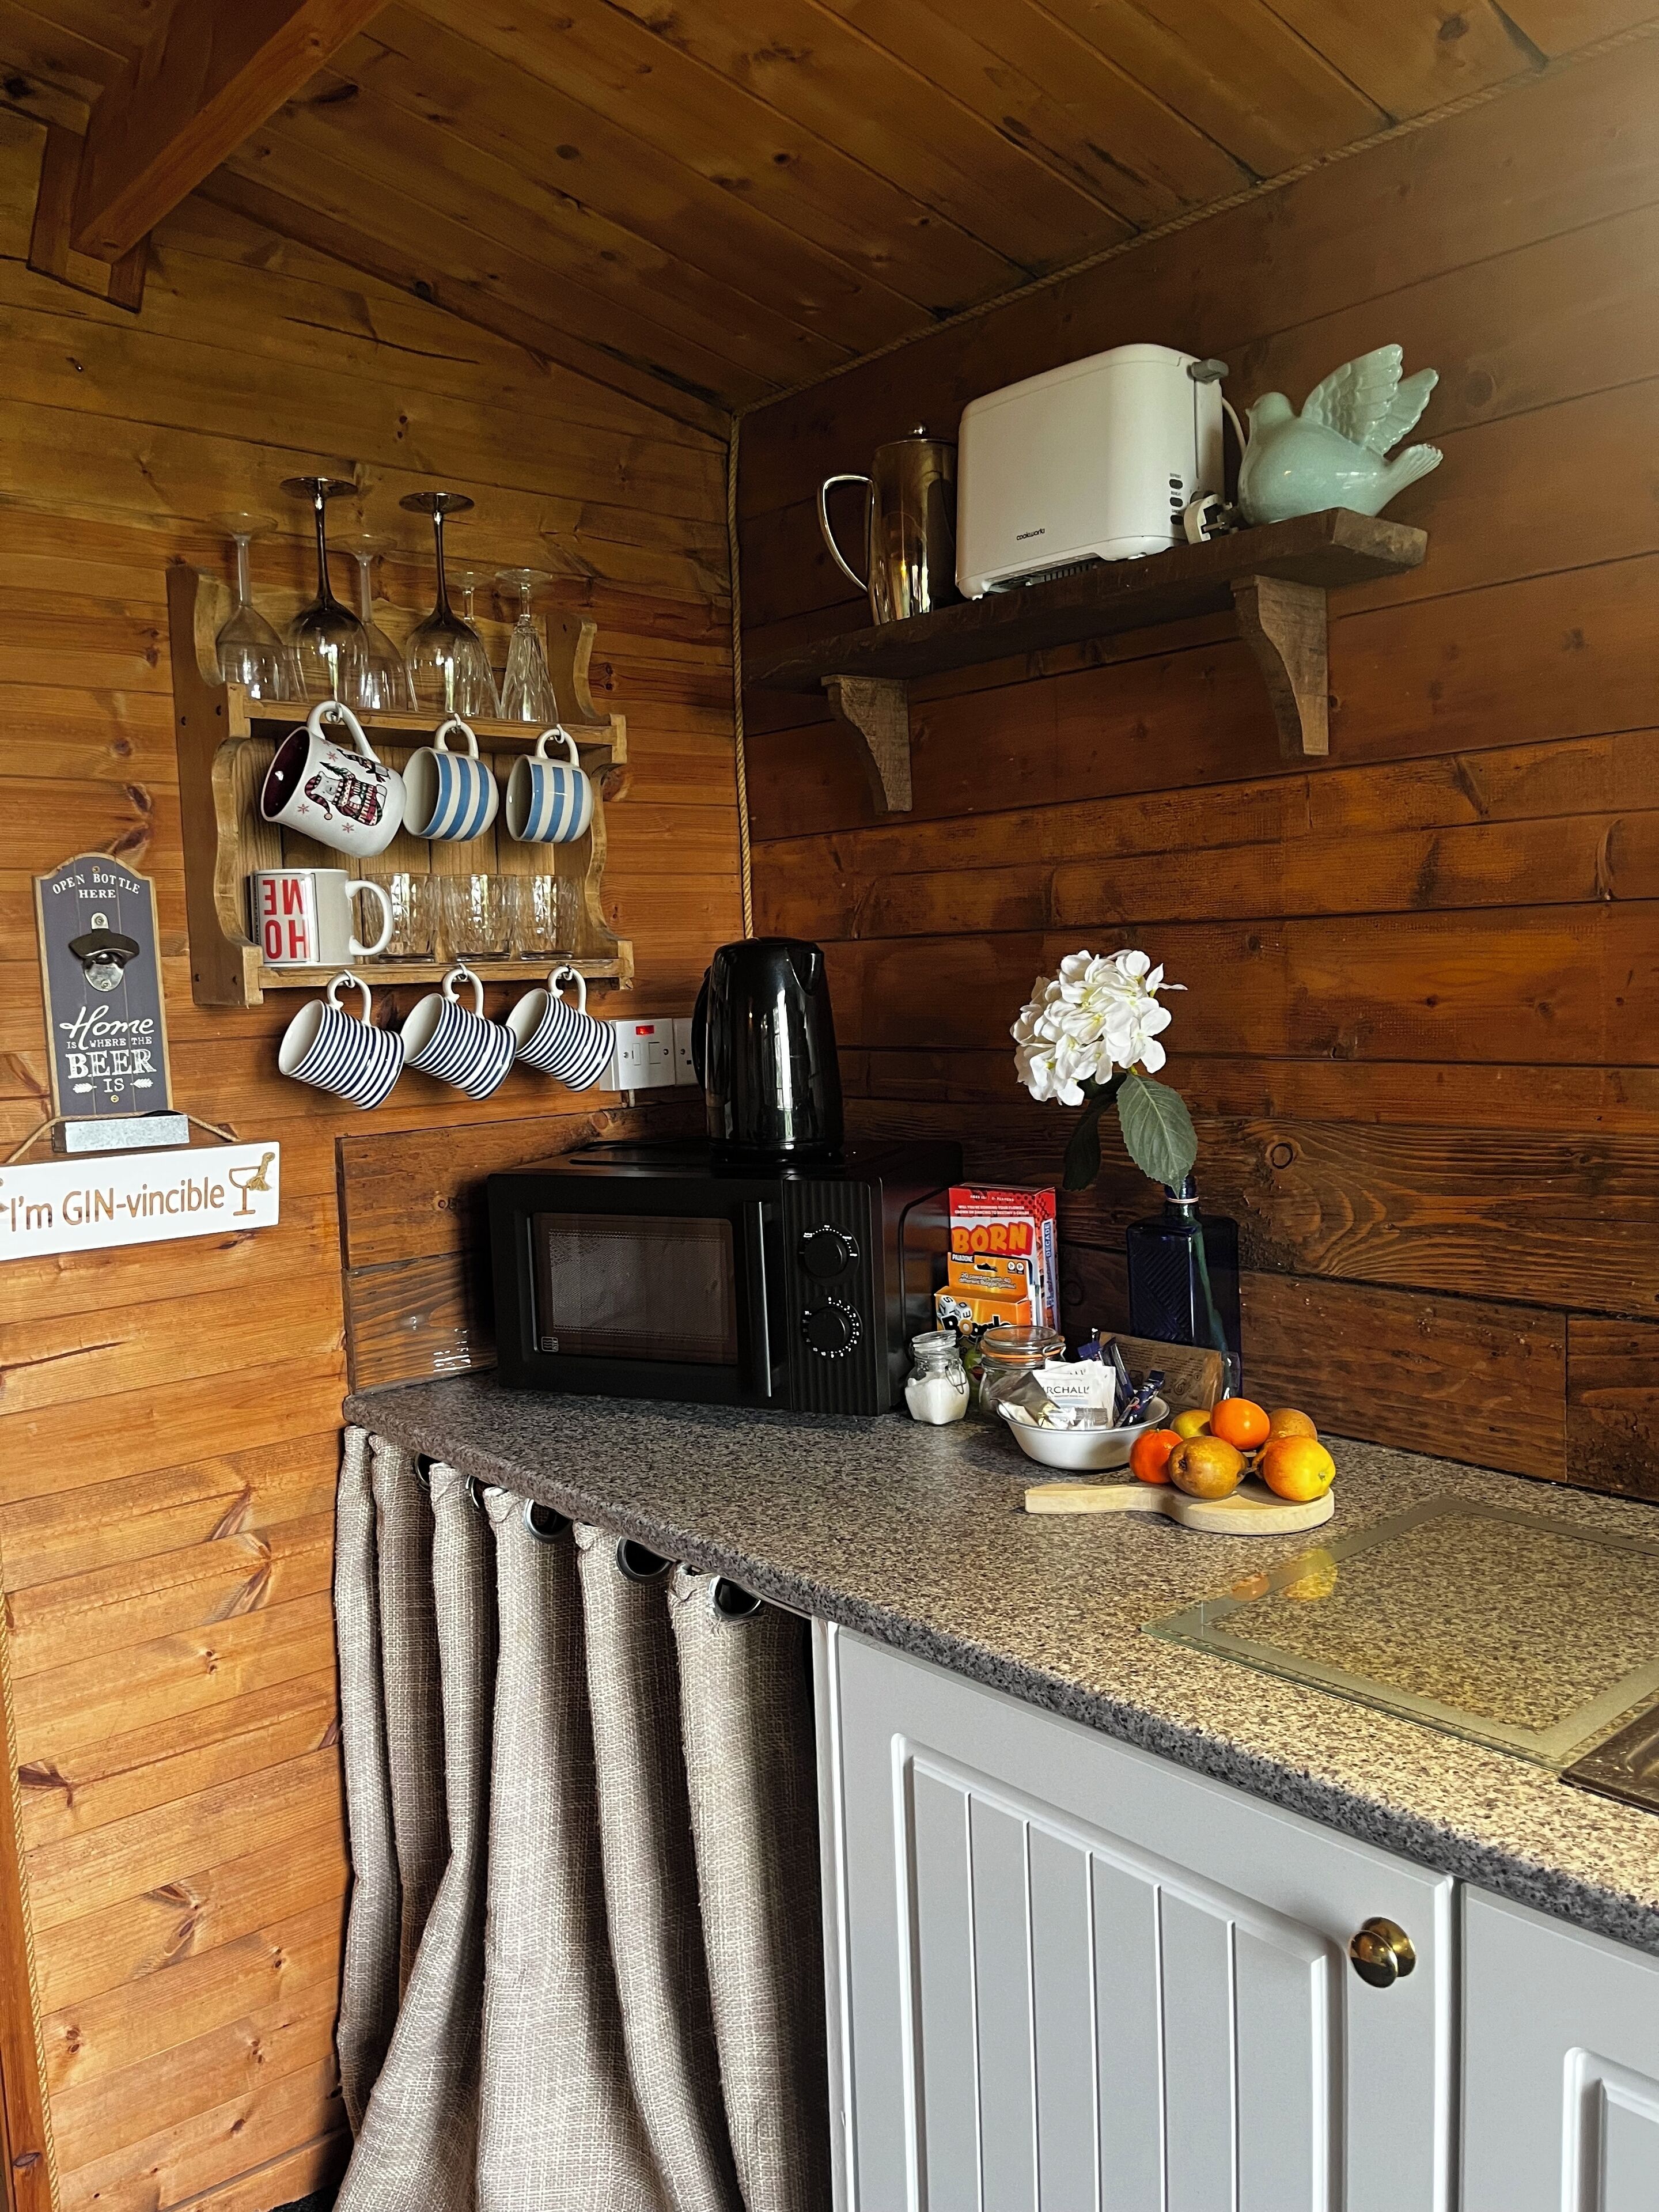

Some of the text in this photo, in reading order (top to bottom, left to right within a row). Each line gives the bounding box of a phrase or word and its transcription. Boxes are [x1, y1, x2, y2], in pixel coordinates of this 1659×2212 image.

[52, 873, 141, 895] OPEN BOTTLE
[78, 889, 116, 899] HERE
[59, 1005, 154, 1050] Home
[66, 1036, 153, 1050] IS WHERE THE
[65, 1048, 157, 1080] BEER
[103, 1077, 125, 1093] IS
[11, 1176, 225, 1232] I'm GIN-vincible
[951, 1222, 1030, 1254] BORN
